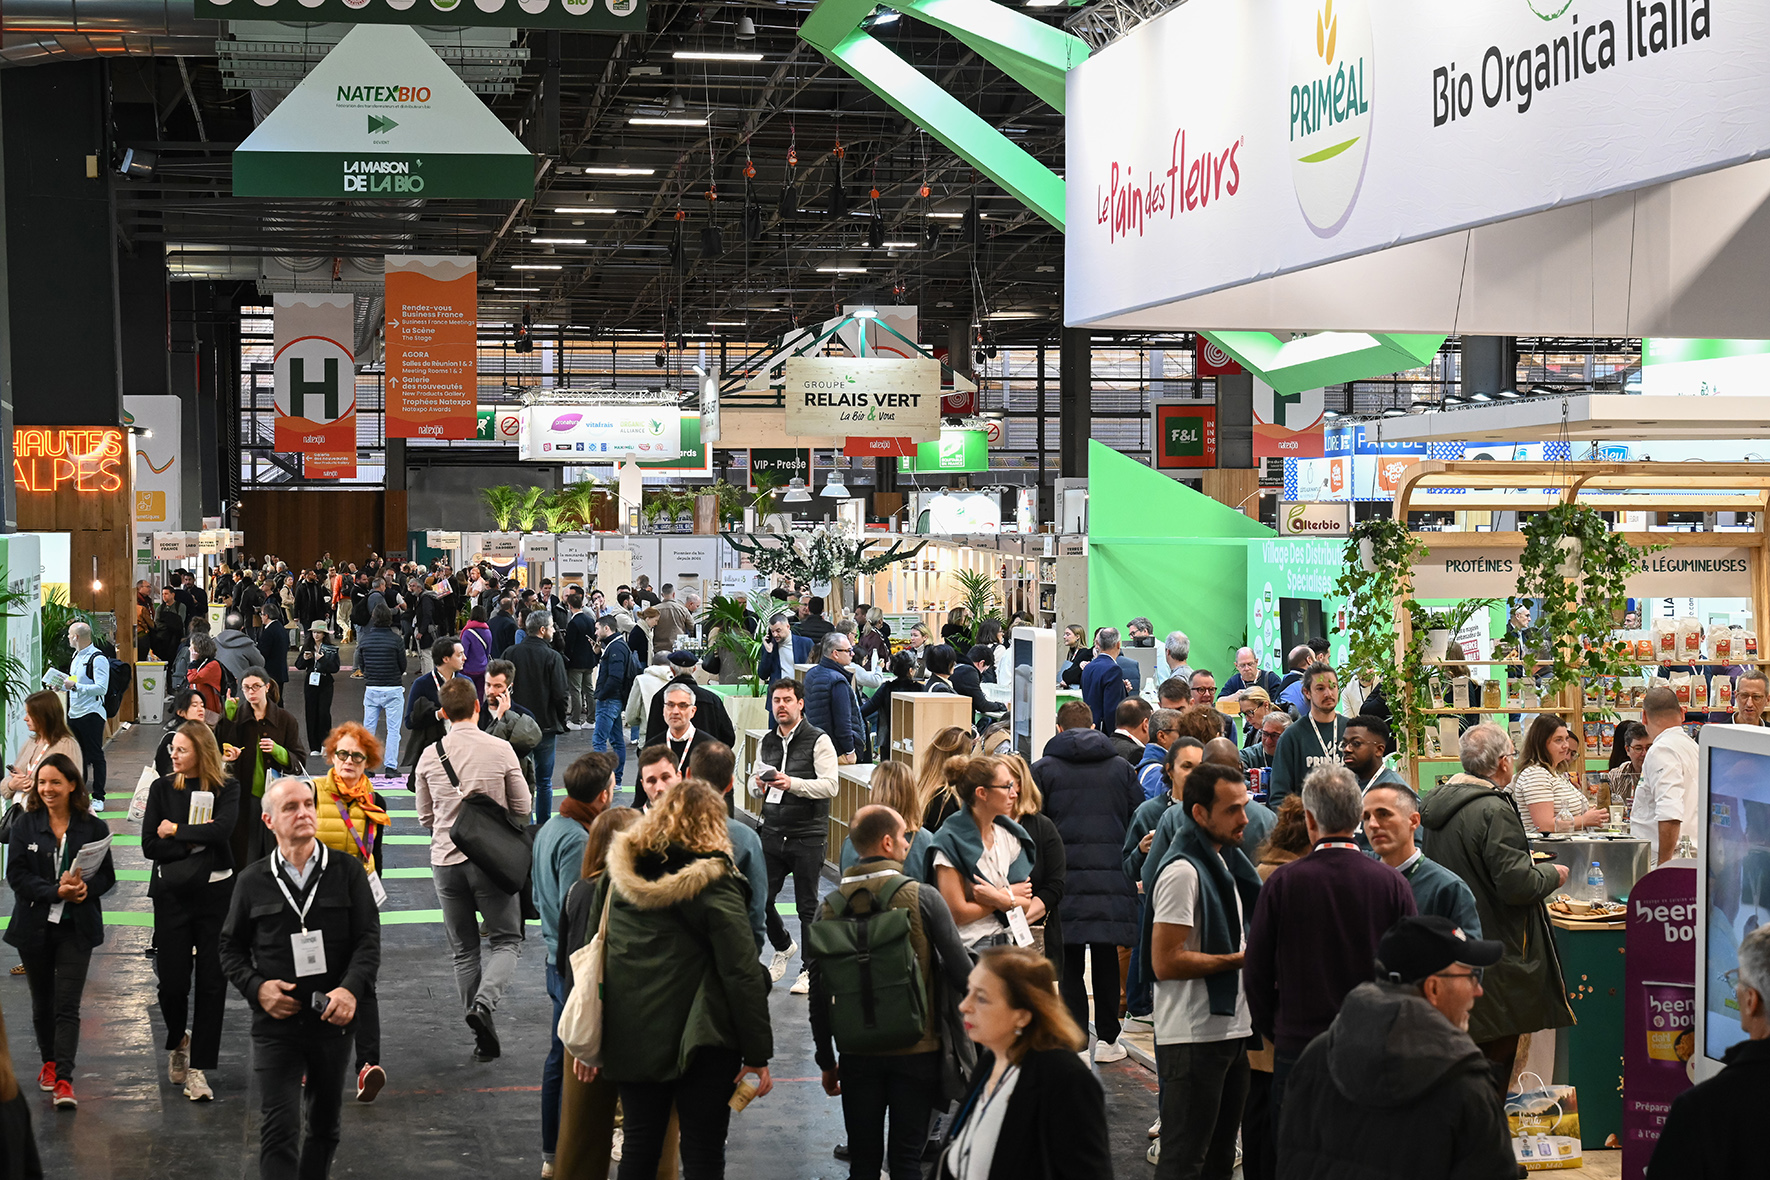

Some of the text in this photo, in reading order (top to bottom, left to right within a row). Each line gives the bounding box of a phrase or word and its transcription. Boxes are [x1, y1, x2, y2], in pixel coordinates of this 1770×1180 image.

[1433, 0, 1710, 127] Bio Organica Italia
[337, 85, 431, 103] NATEXBIO
[343, 161, 409, 173] LA MAISON
[344, 175, 425, 193] DE LA BIO
[1097, 128, 1240, 244] Le Pain des fleurs
[290, 358, 338, 419] H
[804, 381, 845, 389] GROUPE
[402, 398, 438, 406] Trophées
[805, 393, 921, 407] RELAIS VERT
[840, 406, 895, 421] La Bio & Vous
[418, 425, 444, 436] natexpo
[1172, 429, 1198, 441] F&L
[12, 429, 122, 457] HAUTES
[870, 440, 891, 450] natexpo
[754, 460, 769, 469] VIP
[777, 459, 806, 469] Presse
[13, 458, 122, 492] ALPES
[1262, 540, 1288, 571] Village
[1290, 542, 1304, 563] Des
[1445, 556, 1513, 573] PROTÉINES
[1652, 556, 1747, 573] LÉGUMINEUSES
[1287, 568, 1332, 598] Spécialisés
[1635, 900, 1697, 923] been
[1652, 1033, 1671, 1043] dahl
[1638, 1129, 1644, 1138] à
